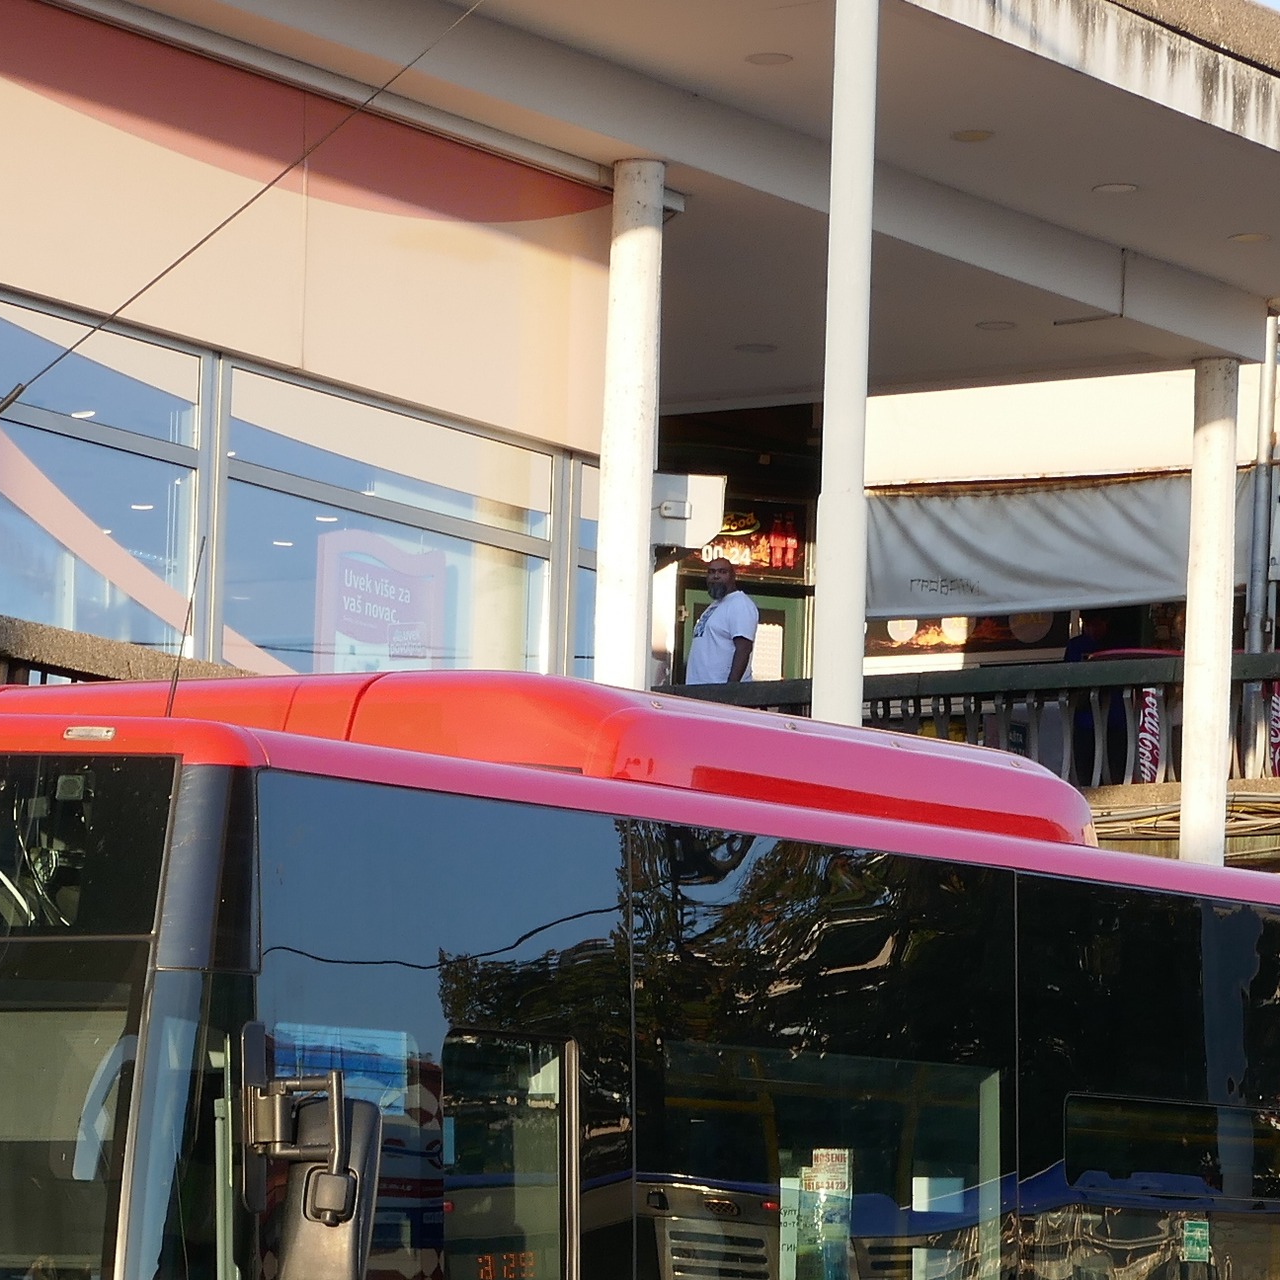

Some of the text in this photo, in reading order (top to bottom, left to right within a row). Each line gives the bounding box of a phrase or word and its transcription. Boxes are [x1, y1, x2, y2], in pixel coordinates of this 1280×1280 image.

[343, 568, 411, 604] Uvek više za
[342, 595, 363, 614] vaš
[364, 601, 401, 624] novac.
